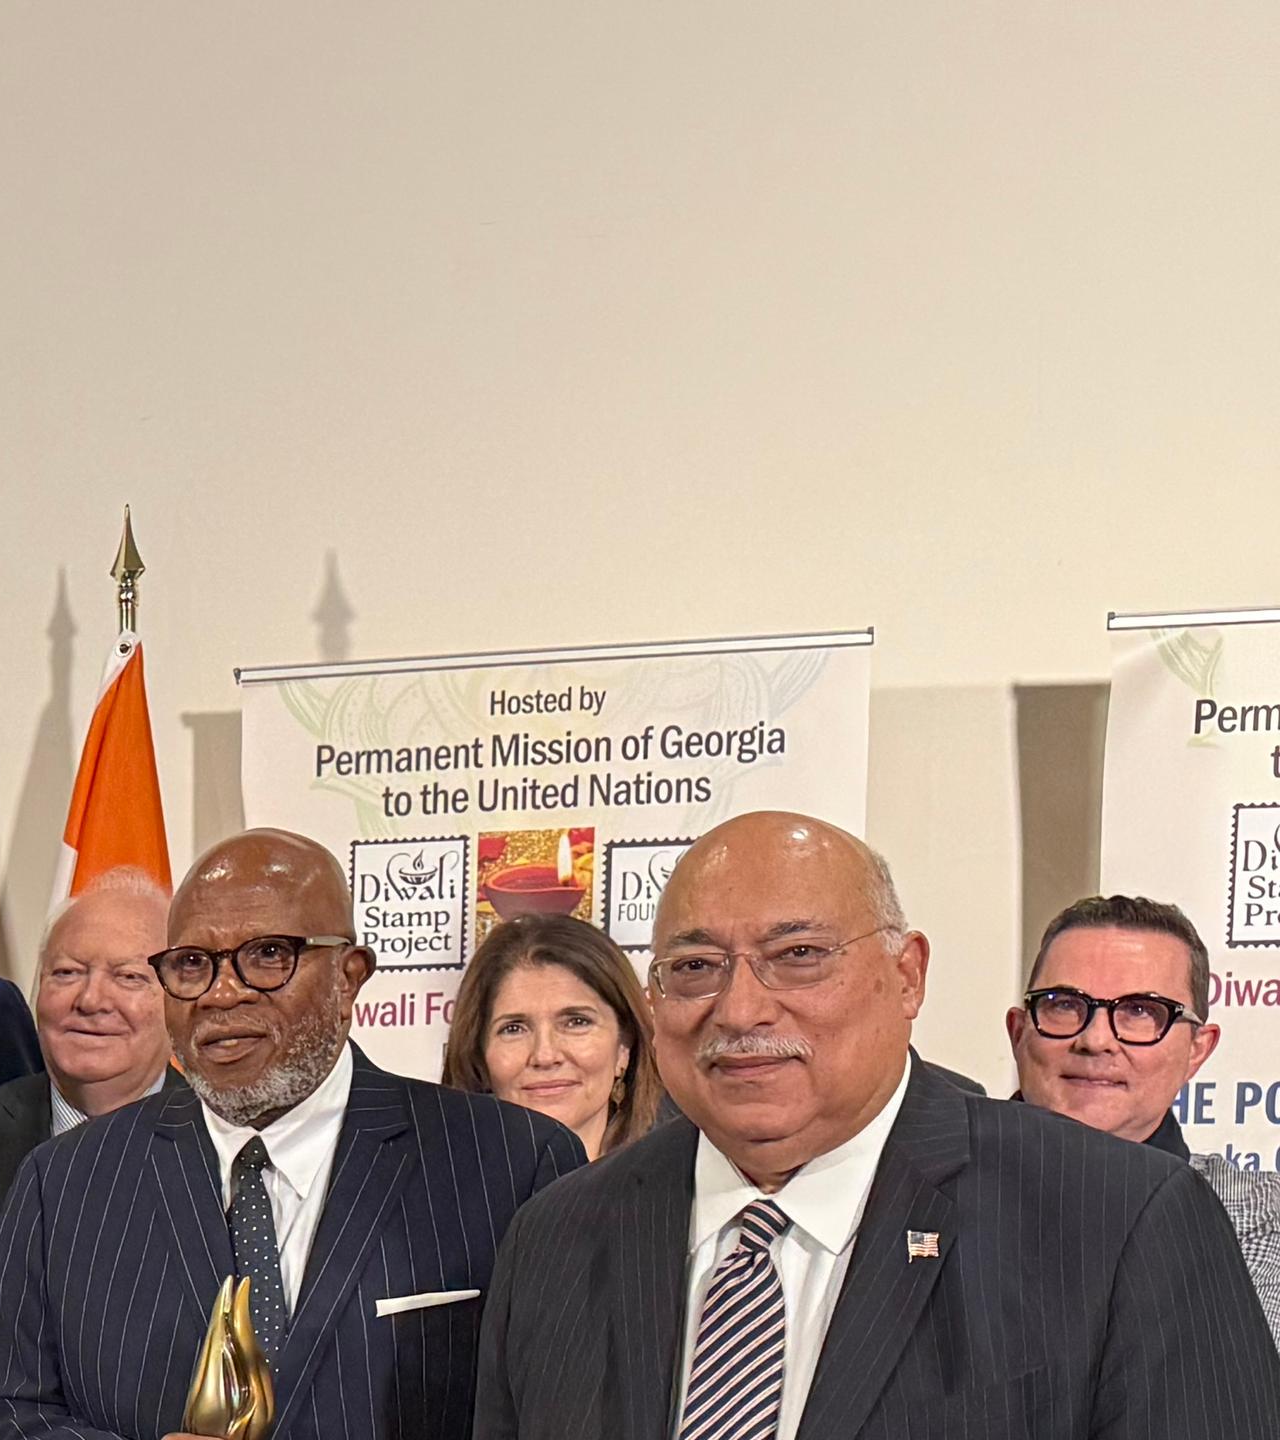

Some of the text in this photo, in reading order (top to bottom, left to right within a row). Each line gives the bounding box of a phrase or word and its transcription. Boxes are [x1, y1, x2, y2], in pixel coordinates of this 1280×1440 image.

[490, 685, 607, 716] Hosted by
[315, 720, 787, 778] Permanent Mission of Georgia
[382, 771, 712, 817] to the United Nations
[359, 849, 459, 903] Diwali
[1247, 875, 1280, 899] St
[364, 906, 451, 932] Stamp
[1244, 902, 1280, 926] Pr
[361, 930, 453, 959] Project
